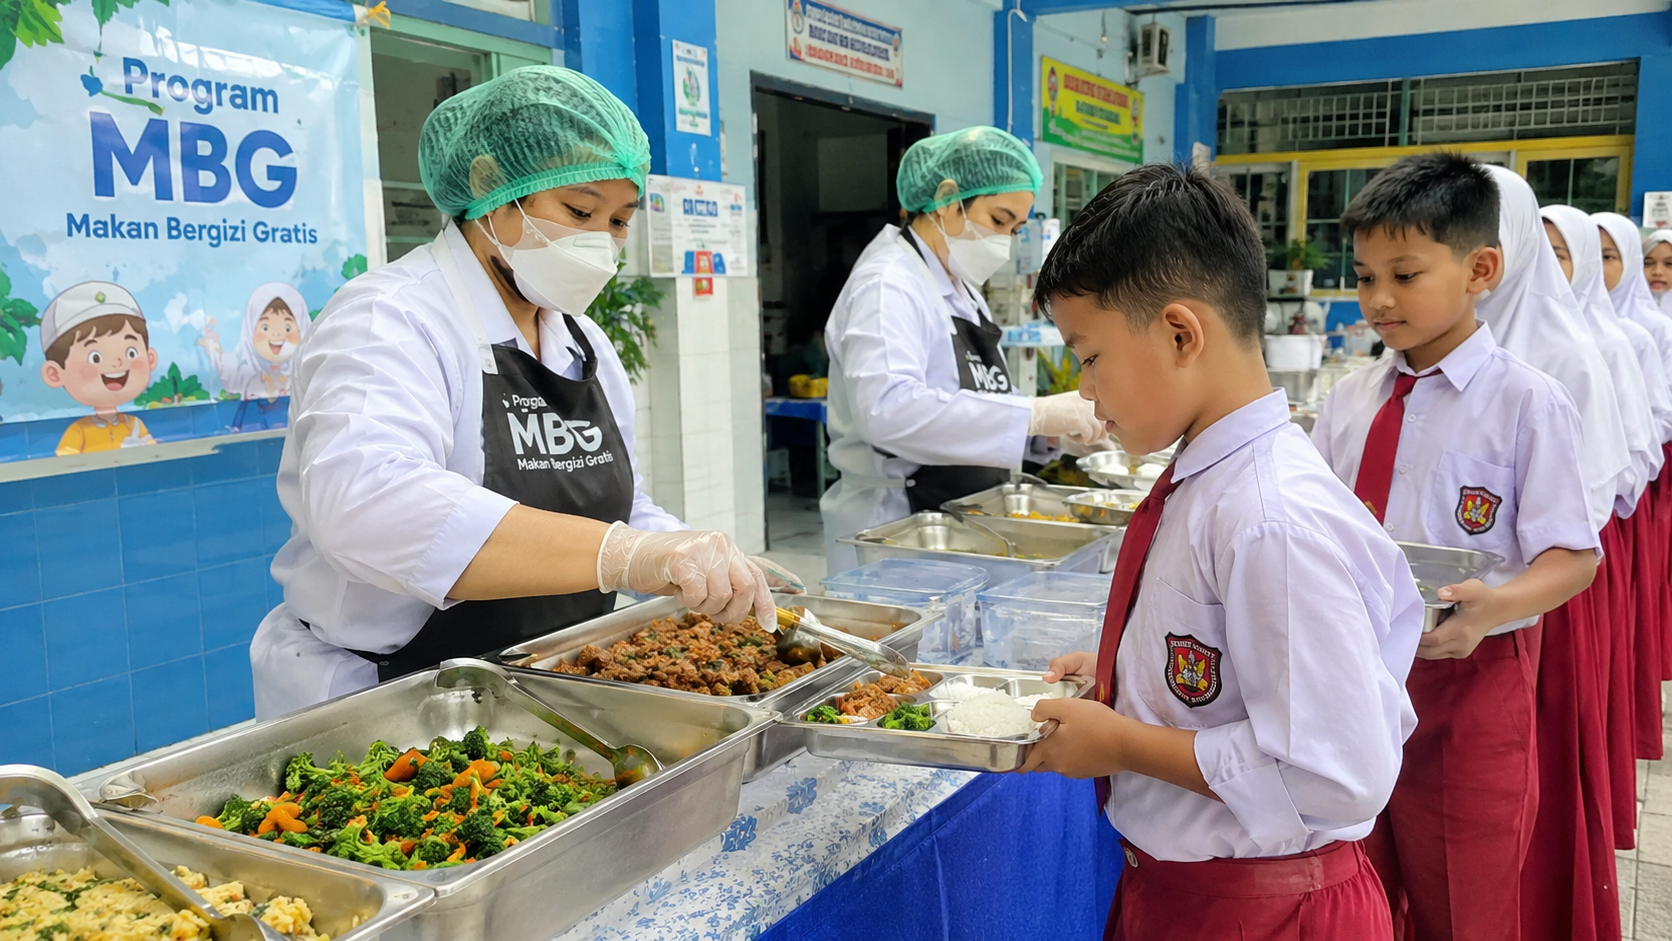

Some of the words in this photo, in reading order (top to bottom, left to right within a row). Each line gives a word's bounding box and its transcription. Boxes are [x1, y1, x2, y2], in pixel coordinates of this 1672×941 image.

[122, 56, 279, 115] Program
[89, 110, 298, 209] MBG
[66, 212, 159, 240] Makan
[166, 216, 246, 249] Bergizi
[252, 220, 318, 245] Gratis
[507, 412, 603, 455] MBG
[517, 457, 551, 471] Makan
[585, 450, 614, 467] Gratis
